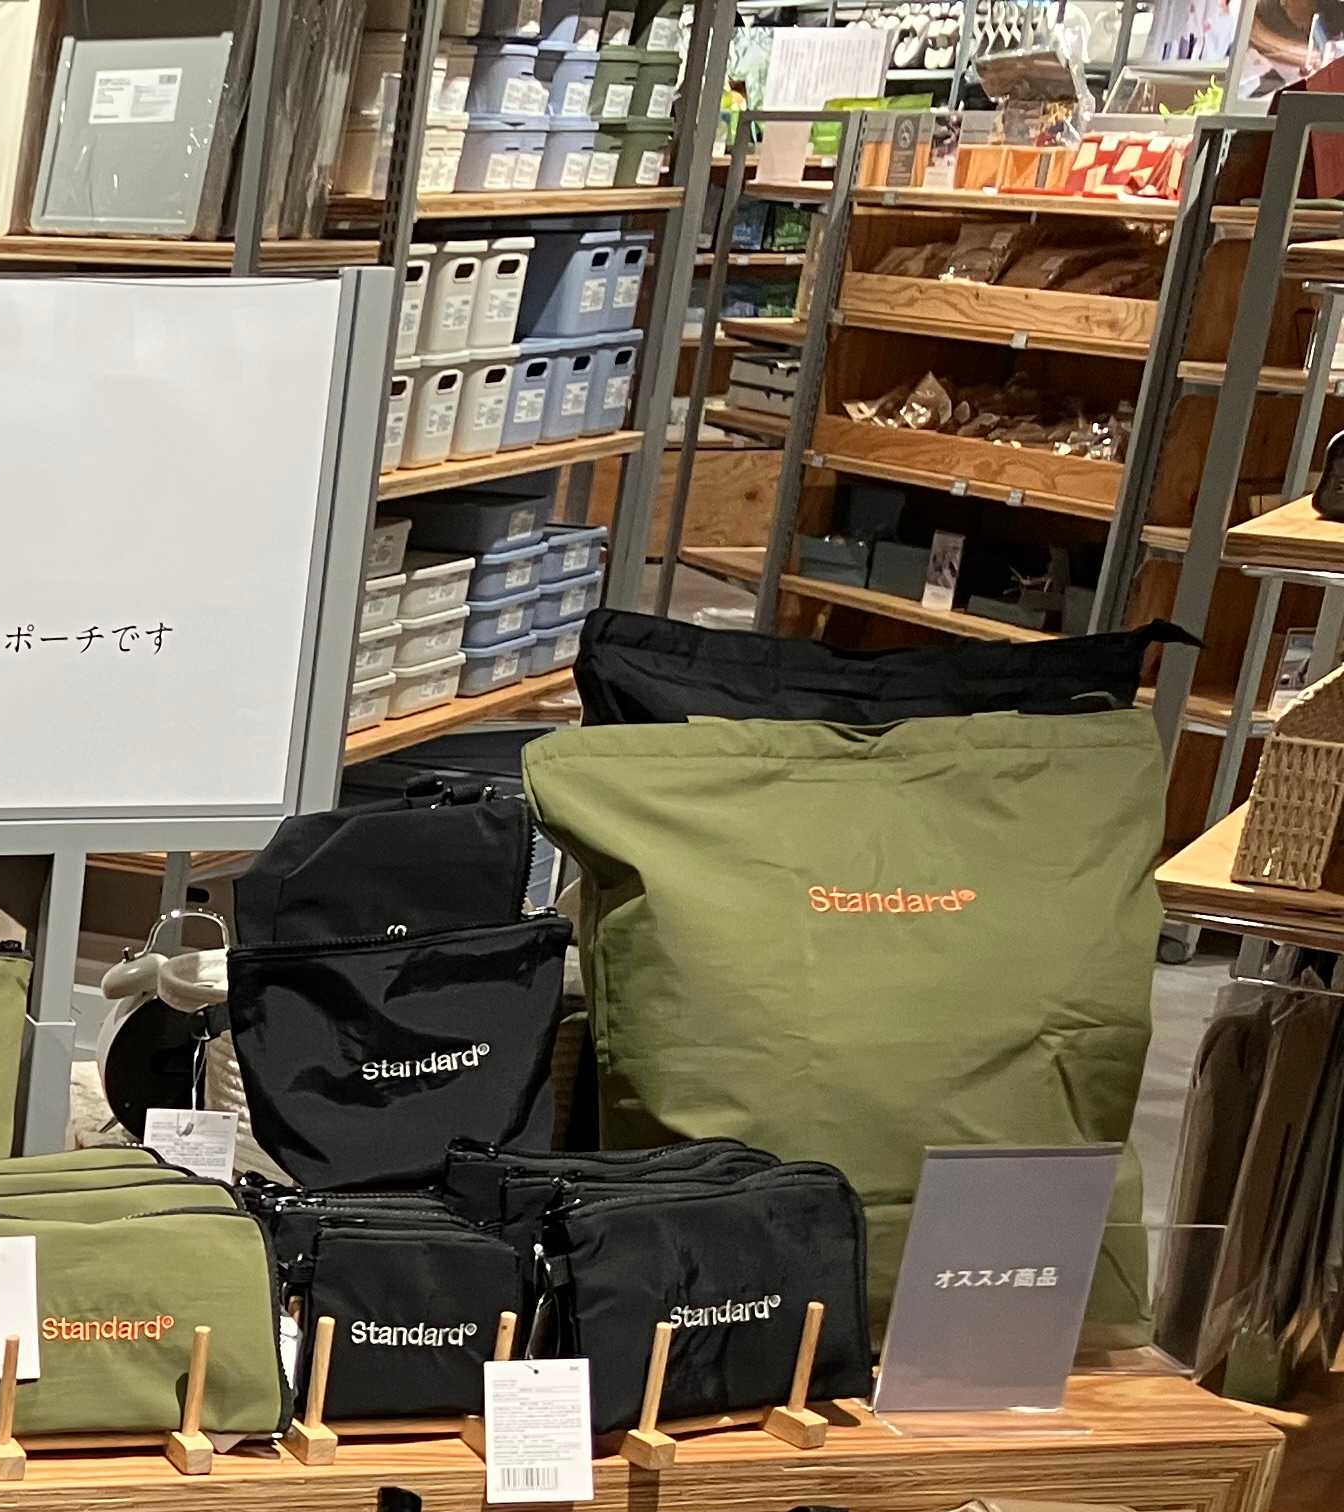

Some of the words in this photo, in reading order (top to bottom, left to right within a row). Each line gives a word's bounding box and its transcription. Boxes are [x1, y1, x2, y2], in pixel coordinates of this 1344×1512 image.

[934, 1266, 1059, 1289] オススメ商品
